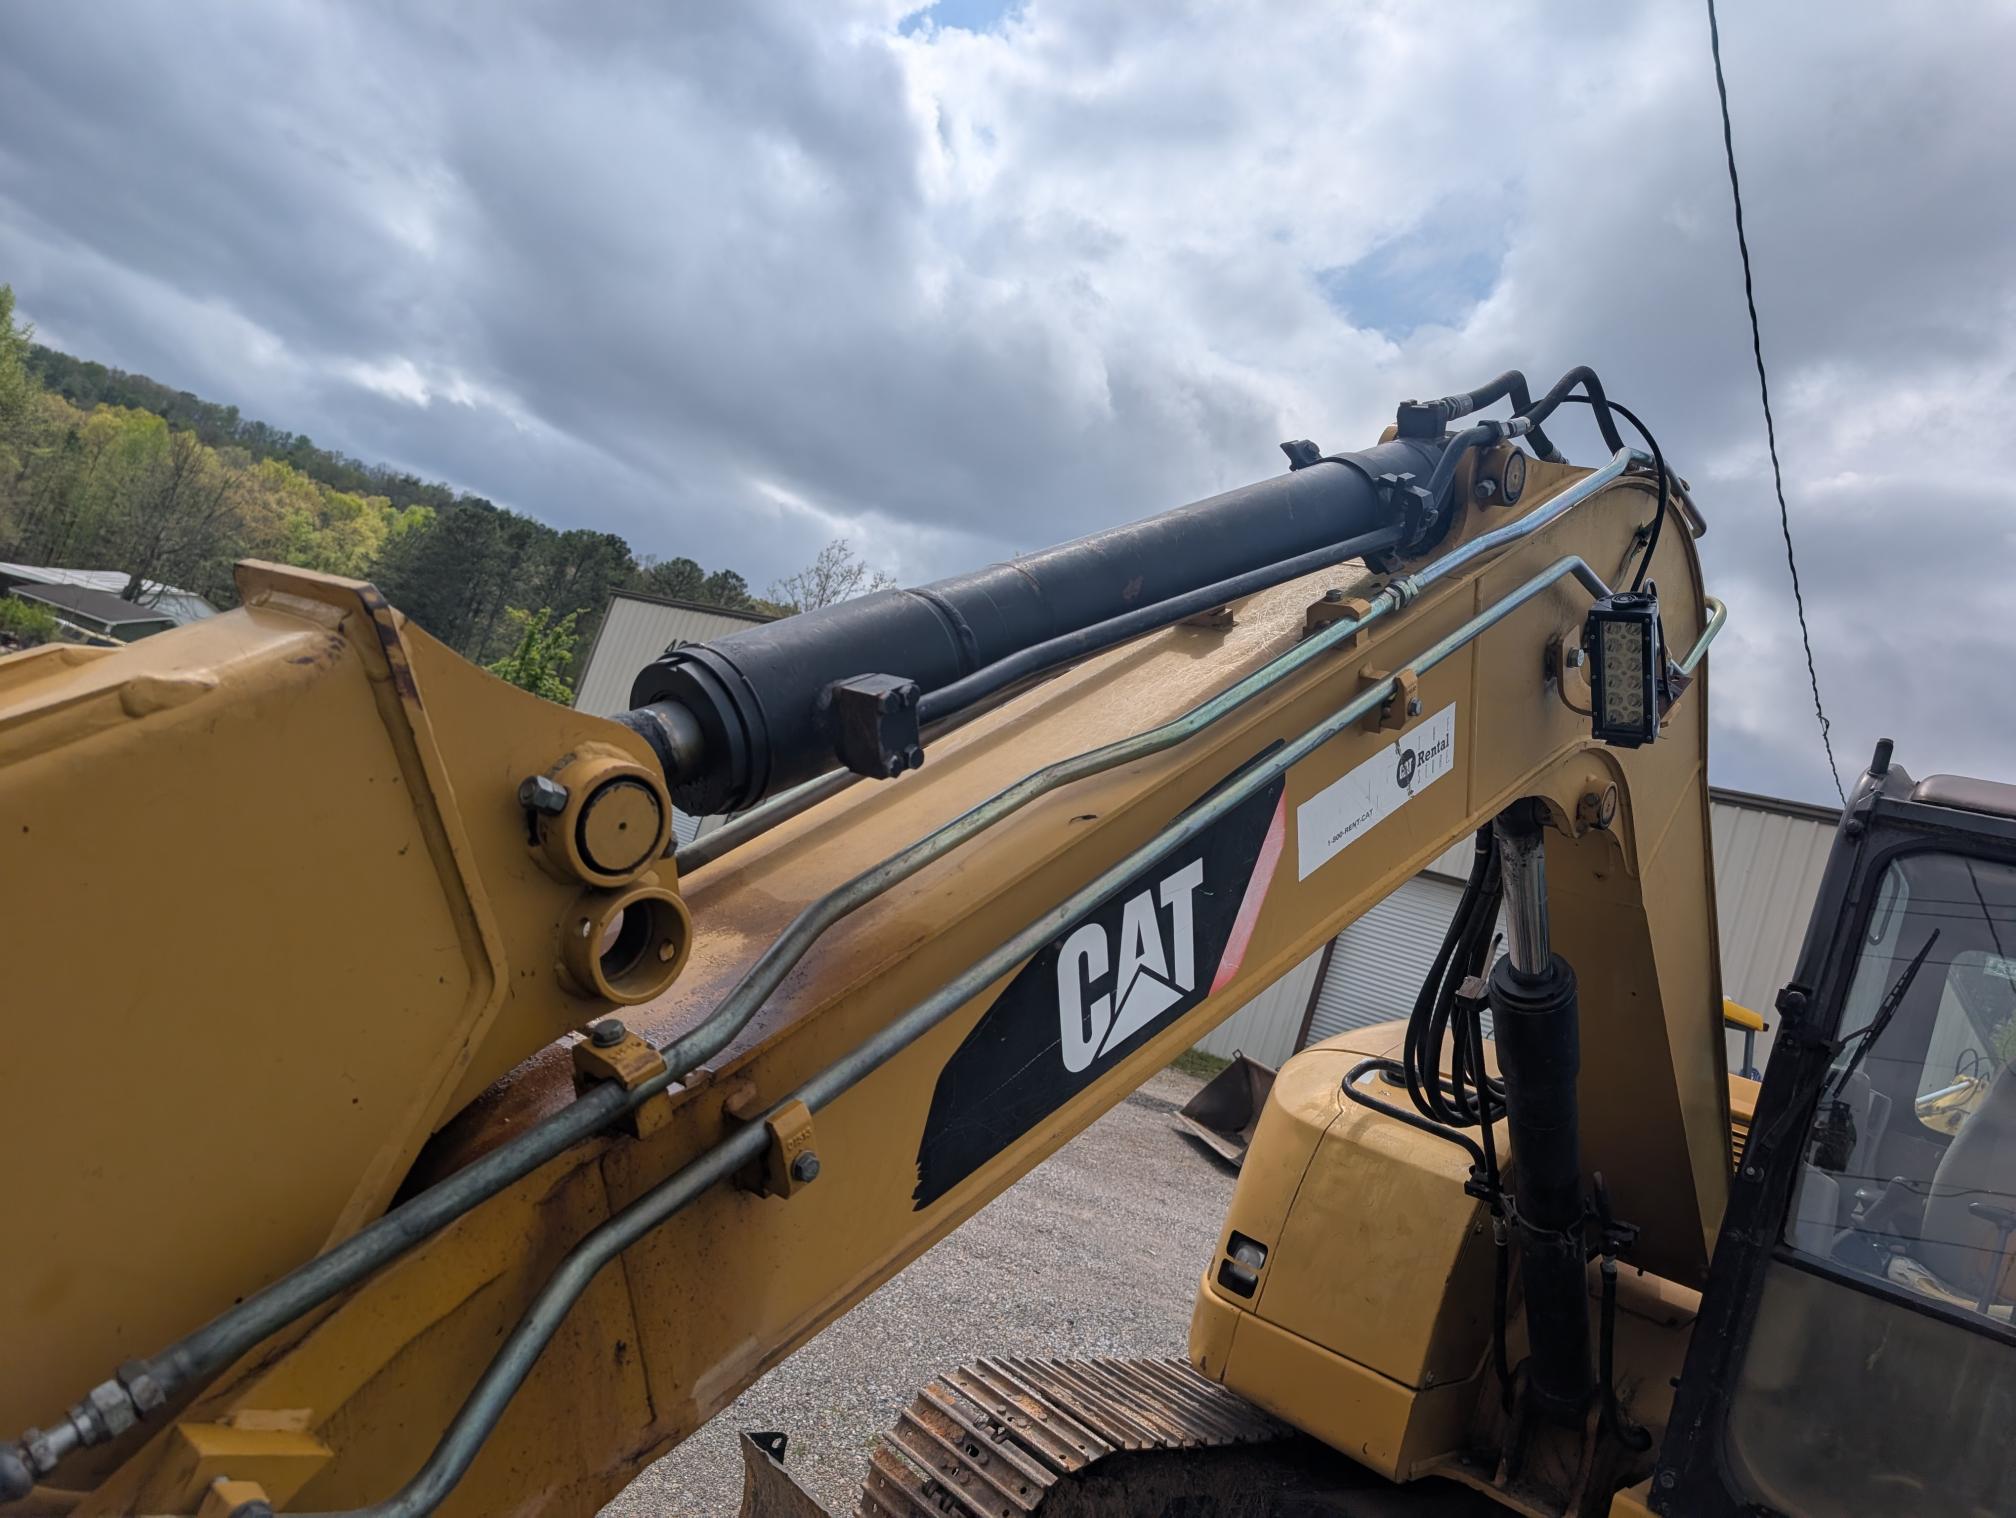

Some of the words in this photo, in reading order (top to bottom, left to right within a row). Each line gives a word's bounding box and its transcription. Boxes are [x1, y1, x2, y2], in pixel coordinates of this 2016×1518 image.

[1417, 733, 1449, 767] Rental
[1328, 808, 1373, 846] 1-800-RENT-CAT
[1057, 857, 1203, 1073] CAT
